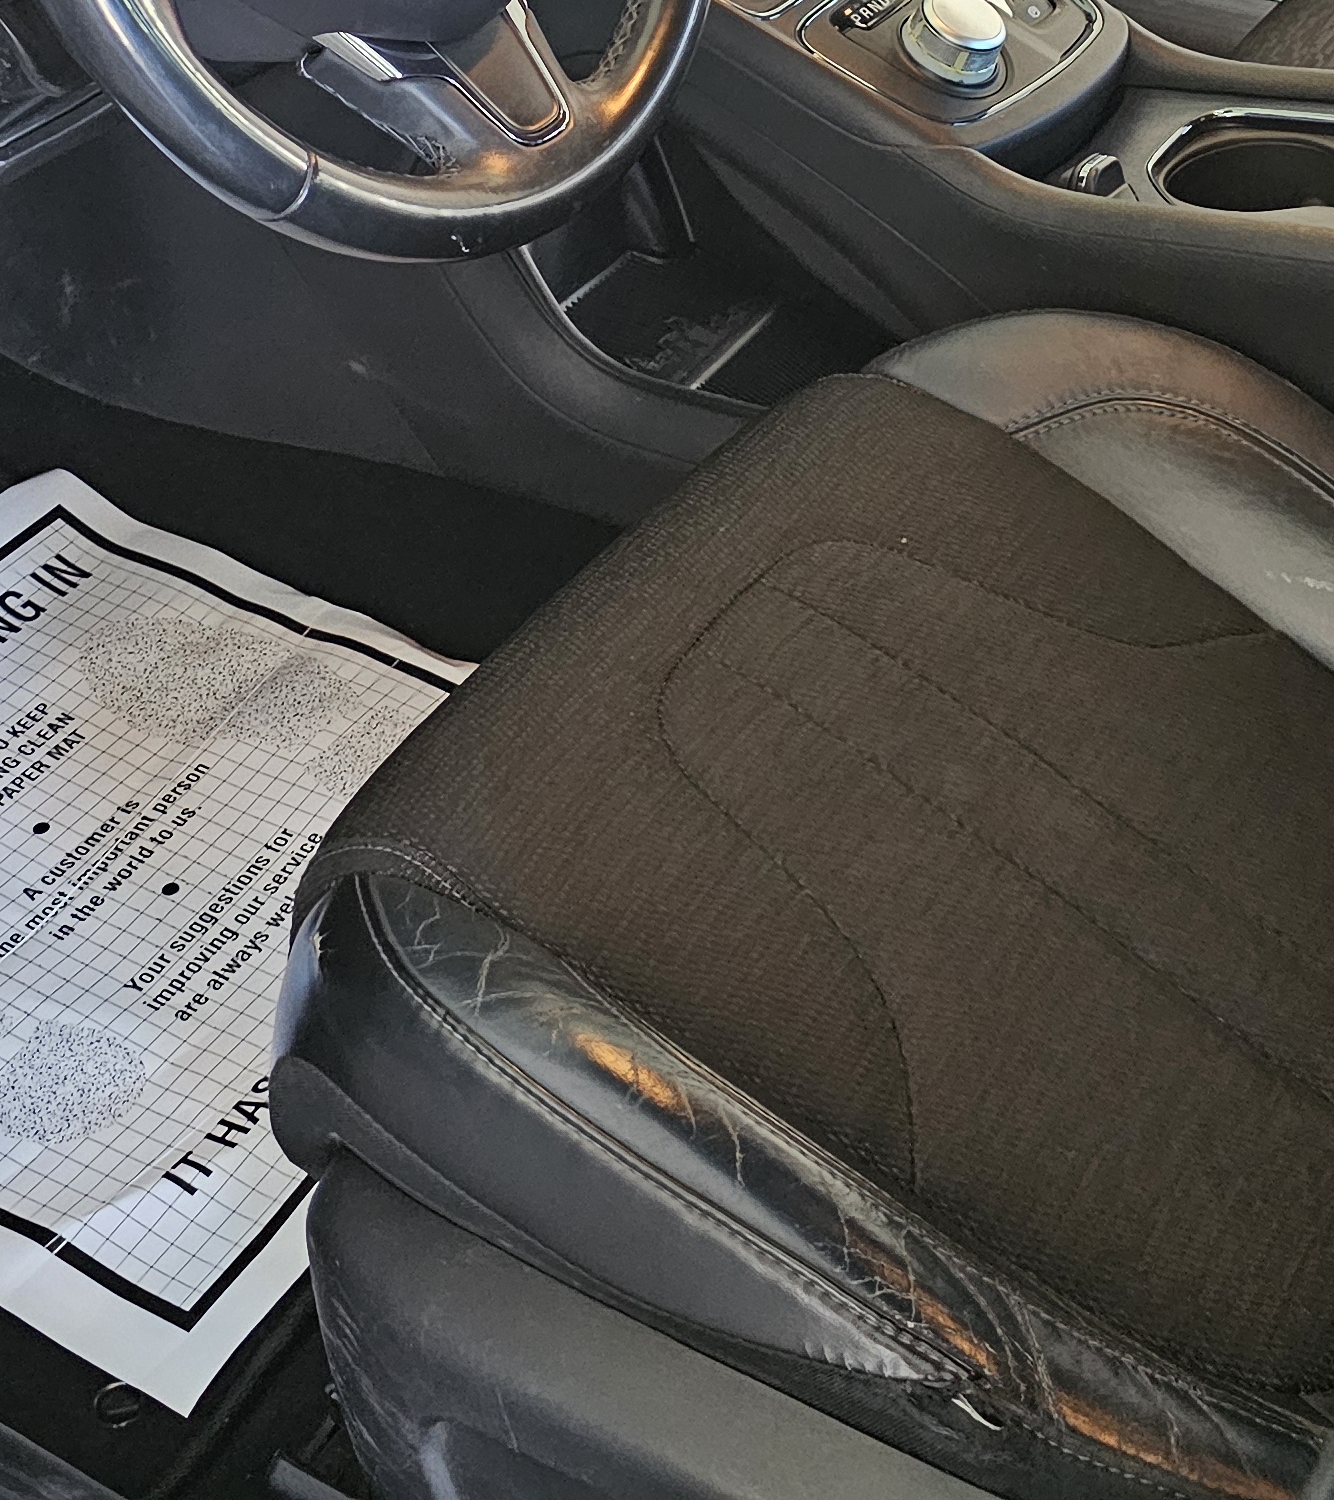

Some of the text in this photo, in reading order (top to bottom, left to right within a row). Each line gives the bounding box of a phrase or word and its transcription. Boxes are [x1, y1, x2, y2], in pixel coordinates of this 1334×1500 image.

[30, 553, 93, 597] IN
[6, 702, 49, 738] KEEP
[17, 712, 76, 756] CLEAN
[46, 729, 86, 761] MAT
[22, 800, 140, 901] A customer is
[25, 890, 75, 931] most
[68, 815, 155, 891] important
[152, 763, 210, 816] person
[49, 806, 202, 941] in the world to us.
[123, 828, 295, 992] Your suggestions for
[142, 832, 323, 1012] improving our service
[174, 993, 210, 1022] are
[207, 930, 270, 991] always
[162, 1150, 213, 1196] IT
